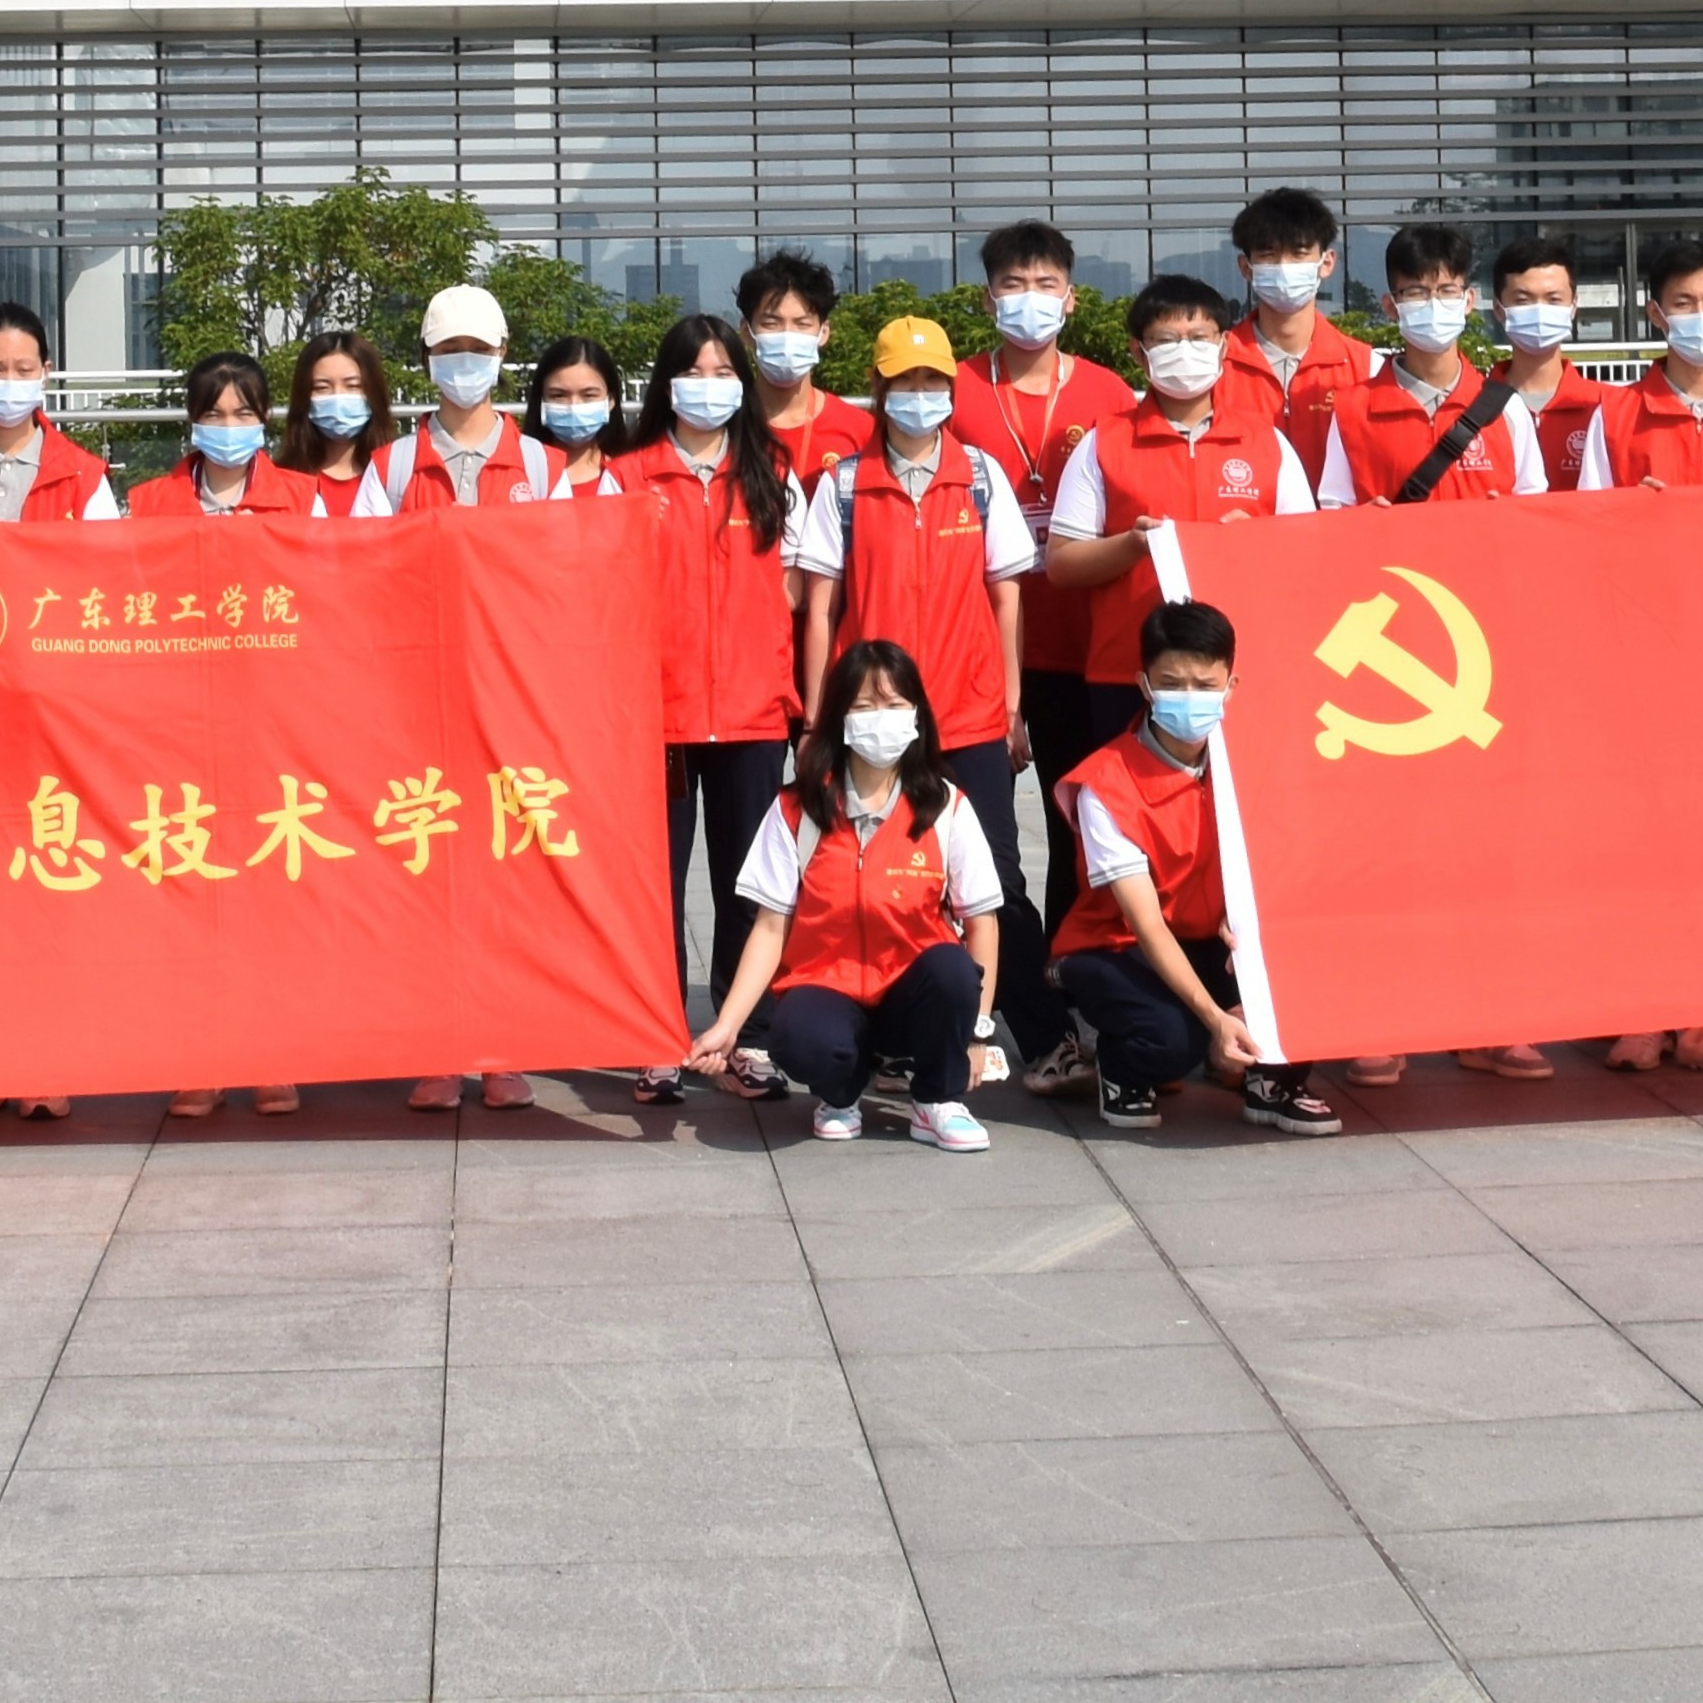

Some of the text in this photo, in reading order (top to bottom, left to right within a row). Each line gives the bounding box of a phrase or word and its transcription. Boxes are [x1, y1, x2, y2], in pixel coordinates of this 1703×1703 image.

[28, 583, 300, 631] 广东理工学院
[31, 633, 299, 654] GUANG DONG POLYTECHNIC COLLEGE
